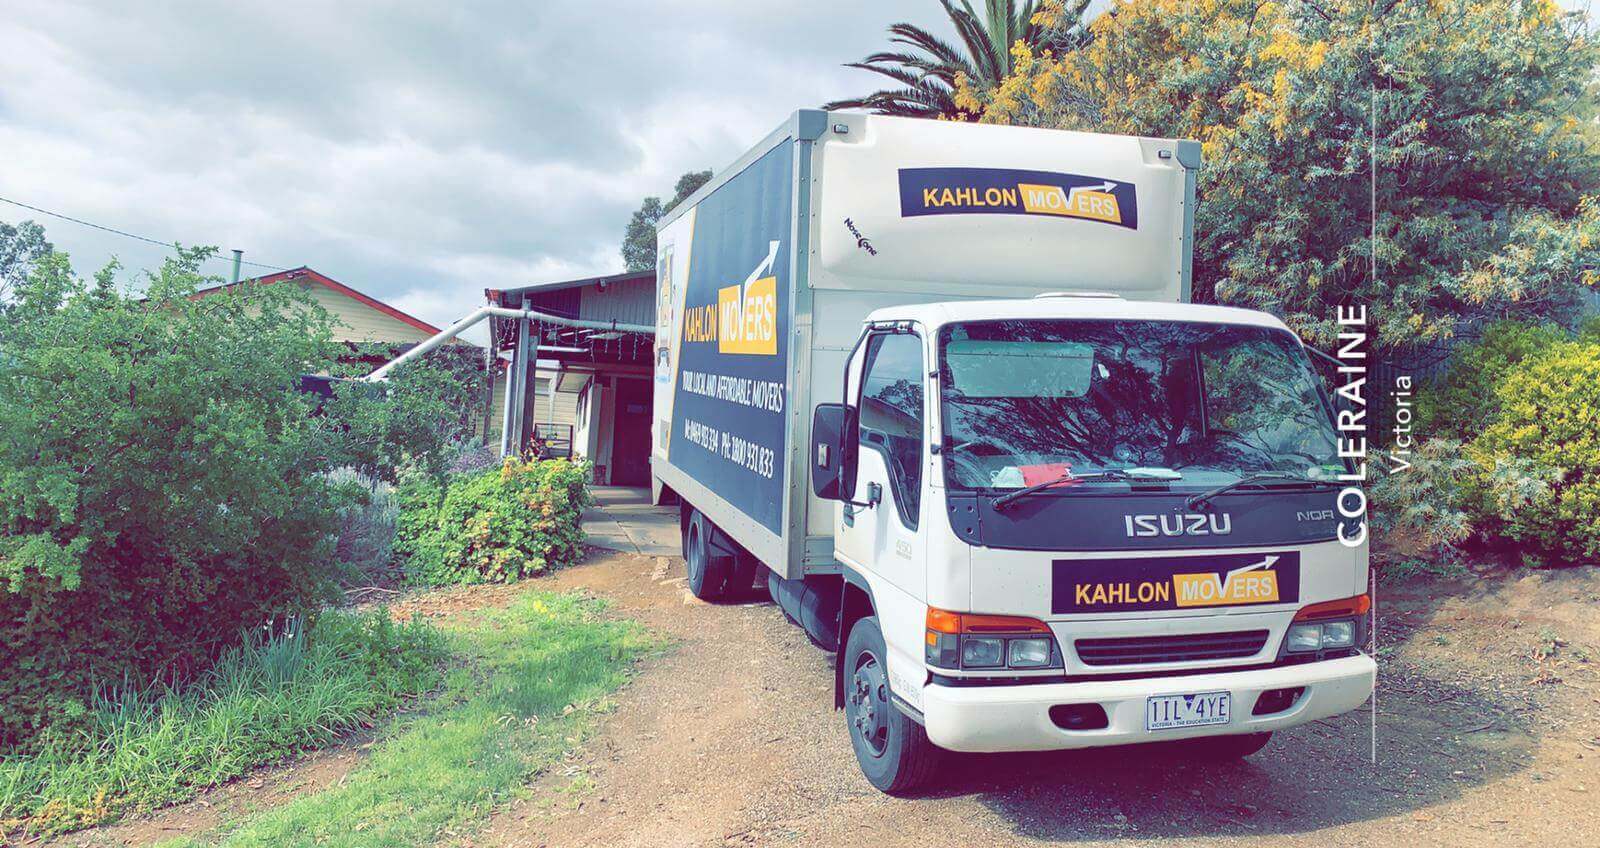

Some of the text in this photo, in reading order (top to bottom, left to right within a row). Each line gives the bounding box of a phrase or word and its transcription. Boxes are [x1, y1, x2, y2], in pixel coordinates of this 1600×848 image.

[923, 186, 1115, 217] KAHLON MOVERS
[684, 284, 773, 342] KAHLON MOVERS
[693, 372, 706, 395] LOCAL
[706, 374, 717, 398] AND
[716, 375, 752, 406] AFFORDABLE
[751, 380, 784, 413] MOVERS
[730, 436, 746, 466] 1800
[746, 442, 758, 473] 931
[757, 446, 773, 479] 833
[1124, 512, 1232, 537] ISUZU
[1075, 573, 1273, 605] KAHLON MOVERS
